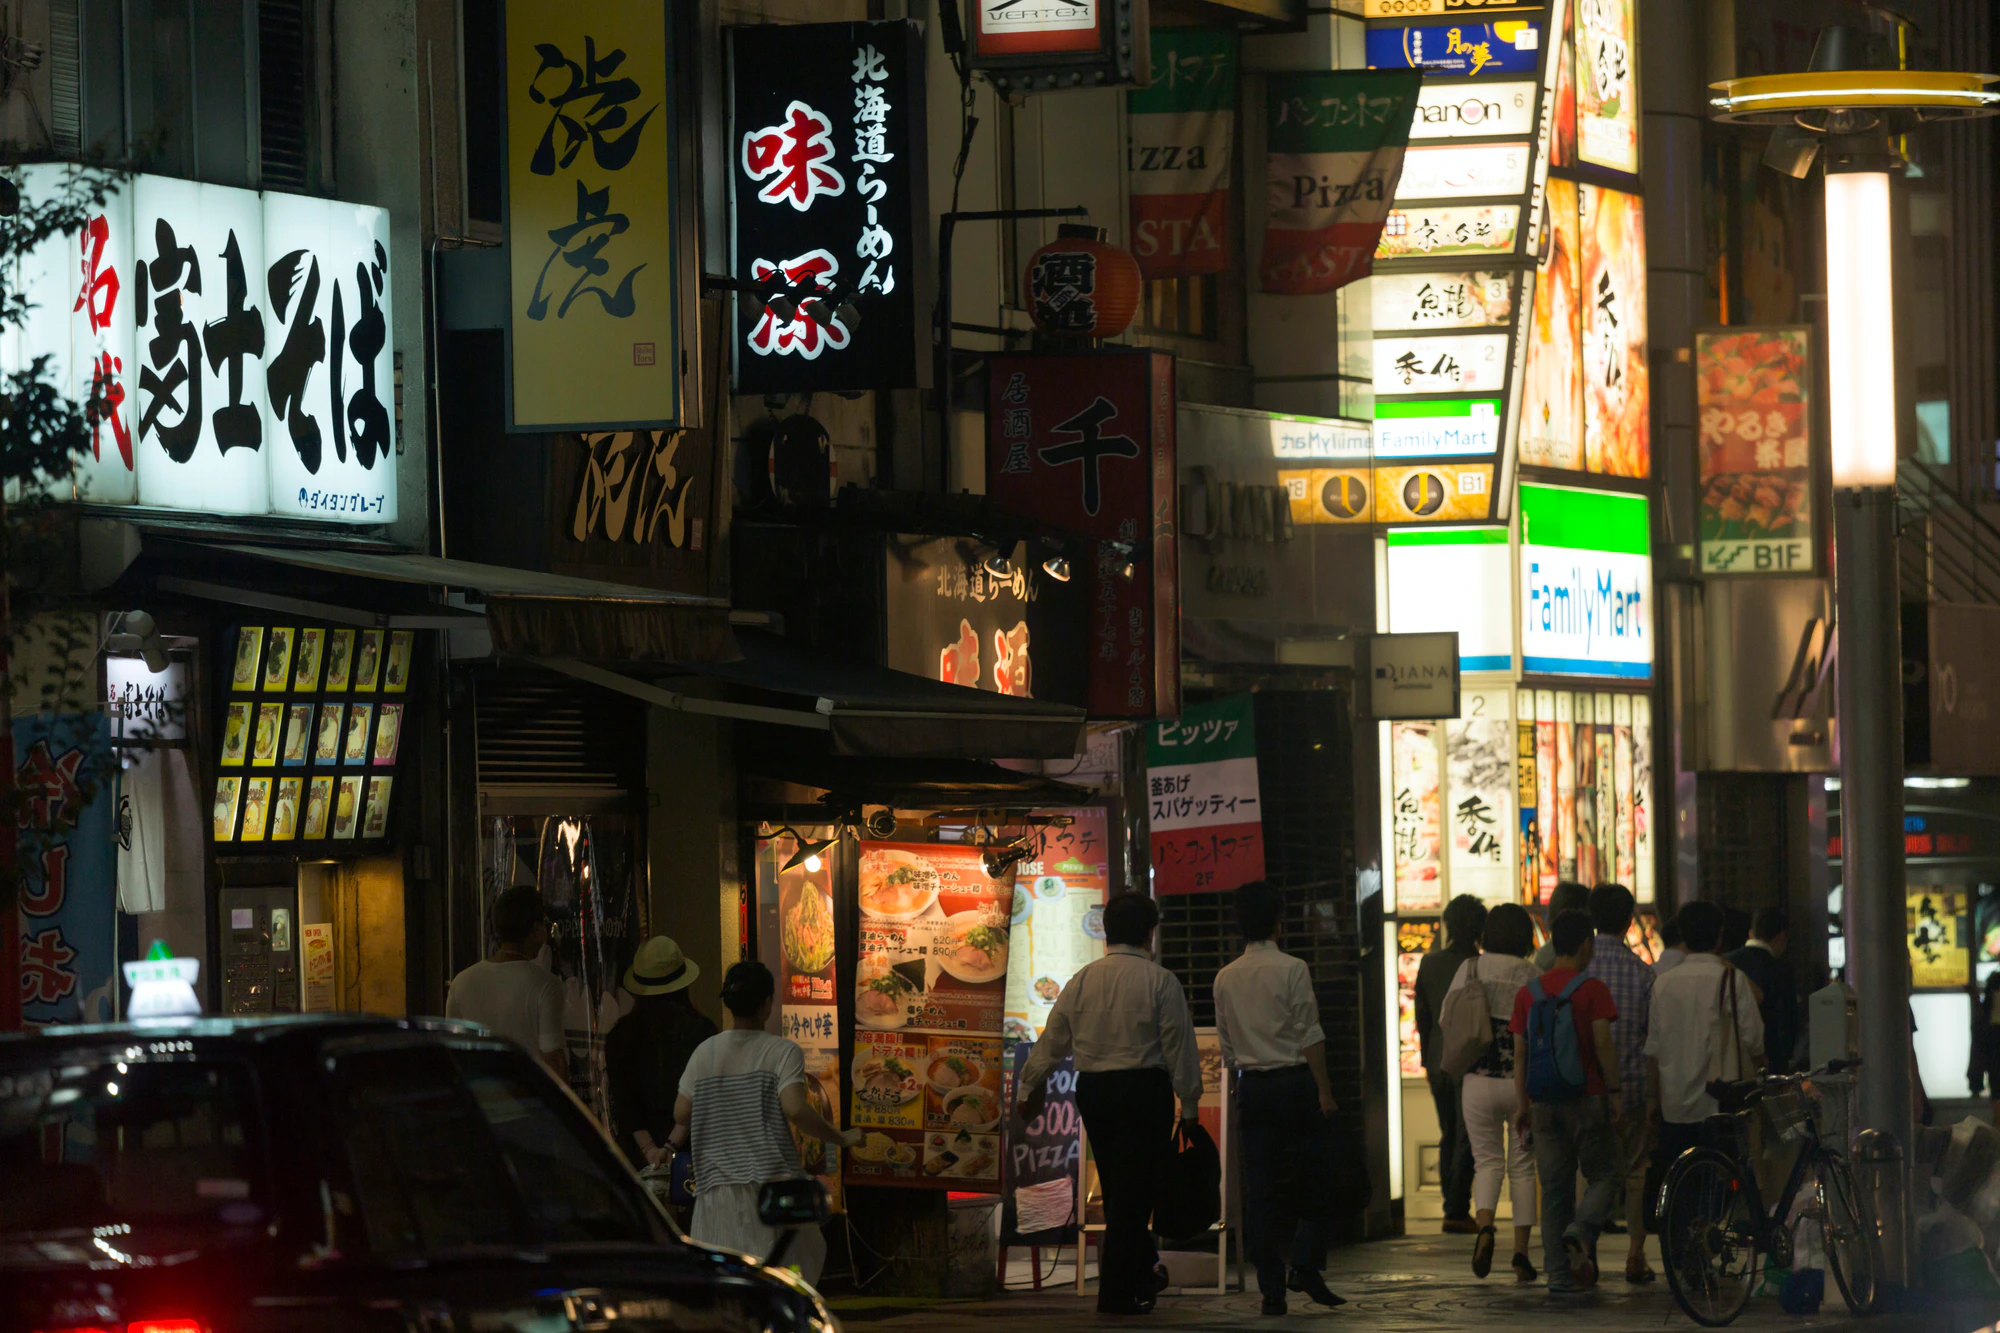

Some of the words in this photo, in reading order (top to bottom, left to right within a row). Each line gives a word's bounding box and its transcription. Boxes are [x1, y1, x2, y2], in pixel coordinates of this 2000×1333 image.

[988, 7, 1090, 21] VERTEX
[1150, 50, 1226, 92] ントマテ
[1276, 91, 1404, 128] パンコントマ
[1513, 92, 1524, 109] 6
[1128, 136, 1207, 171] izza
[852, 43, 894, 296] 北海道らーめん
[1135, 219, 1220, 257] STA
[1491, 282, 1502, 298] 3
[135, 216, 393, 476] 富士そば
[1001, 372, 1032, 474] 居酒屋
[1381, 429, 1488, 450] FamilyMart
[1037, 395, 1140, 517] 千
[1461, 475, 1485, 493] B1
[311, 491, 385, 514] ダイタングループ
[1754, 545, 1801, 569] B1F
[937, 562, 1038, 602] 北海道らーめん
[1530, 563, 1641, 655] FamilyMart
[1386, 663, 1448, 682] DIANA
[1472, 696, 1485, 716] 2
[1158, 720, 1240, 747] ピッツァ
[1151, 774, 1191, 797] 釜あげ
[1153, 794, 1256, 821] スパゲッティー
[1195, 872, 1214, 888] 2F
[932, 946, 958, 956] 890円
[933, 935, 958, 945] 620円
[790, 1012, 834, 1040] 冷やし中華
[1013, 1139, 1079, 1178] PIZZA
